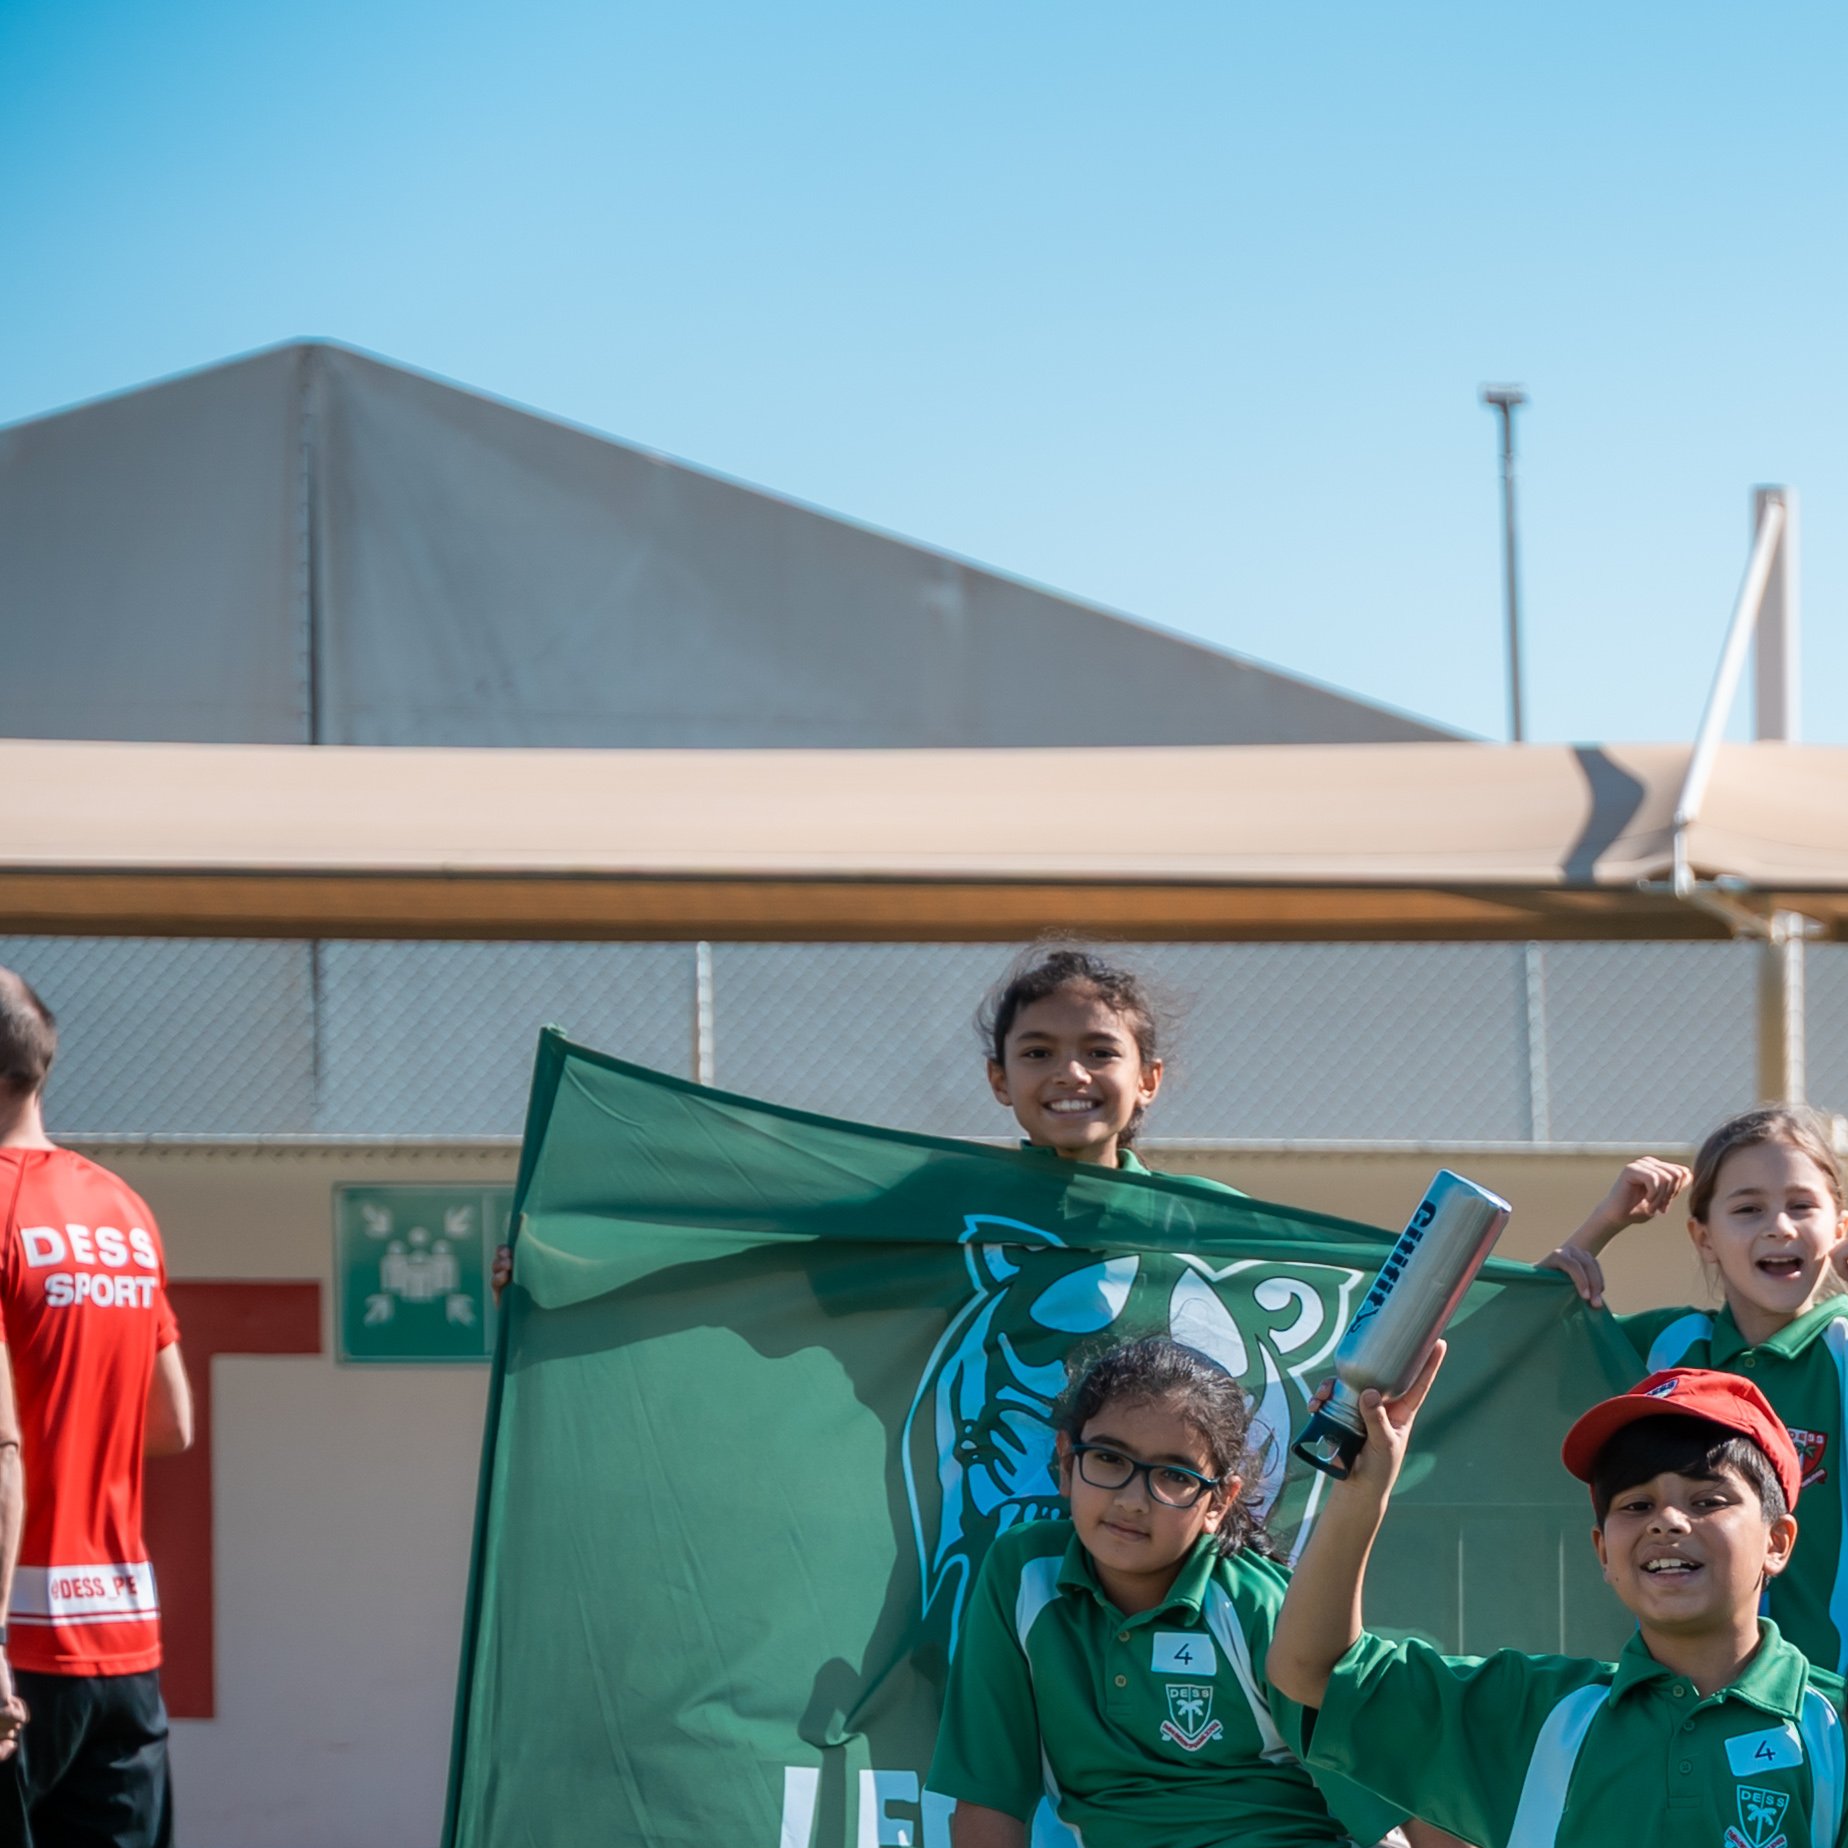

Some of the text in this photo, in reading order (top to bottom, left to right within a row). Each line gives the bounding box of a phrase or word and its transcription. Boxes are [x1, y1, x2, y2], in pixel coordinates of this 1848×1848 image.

[20, 1223, 158, 1269] DESS
[45, 1272, 156, 1308] SPORT
[1173, 1643, 1193, 1666] 4
[1170, 1688, 1210, 1698] DESS
[1754, 1740, 1776, 1761] 4
[1741, 1790, 1785, 1807] DESS
